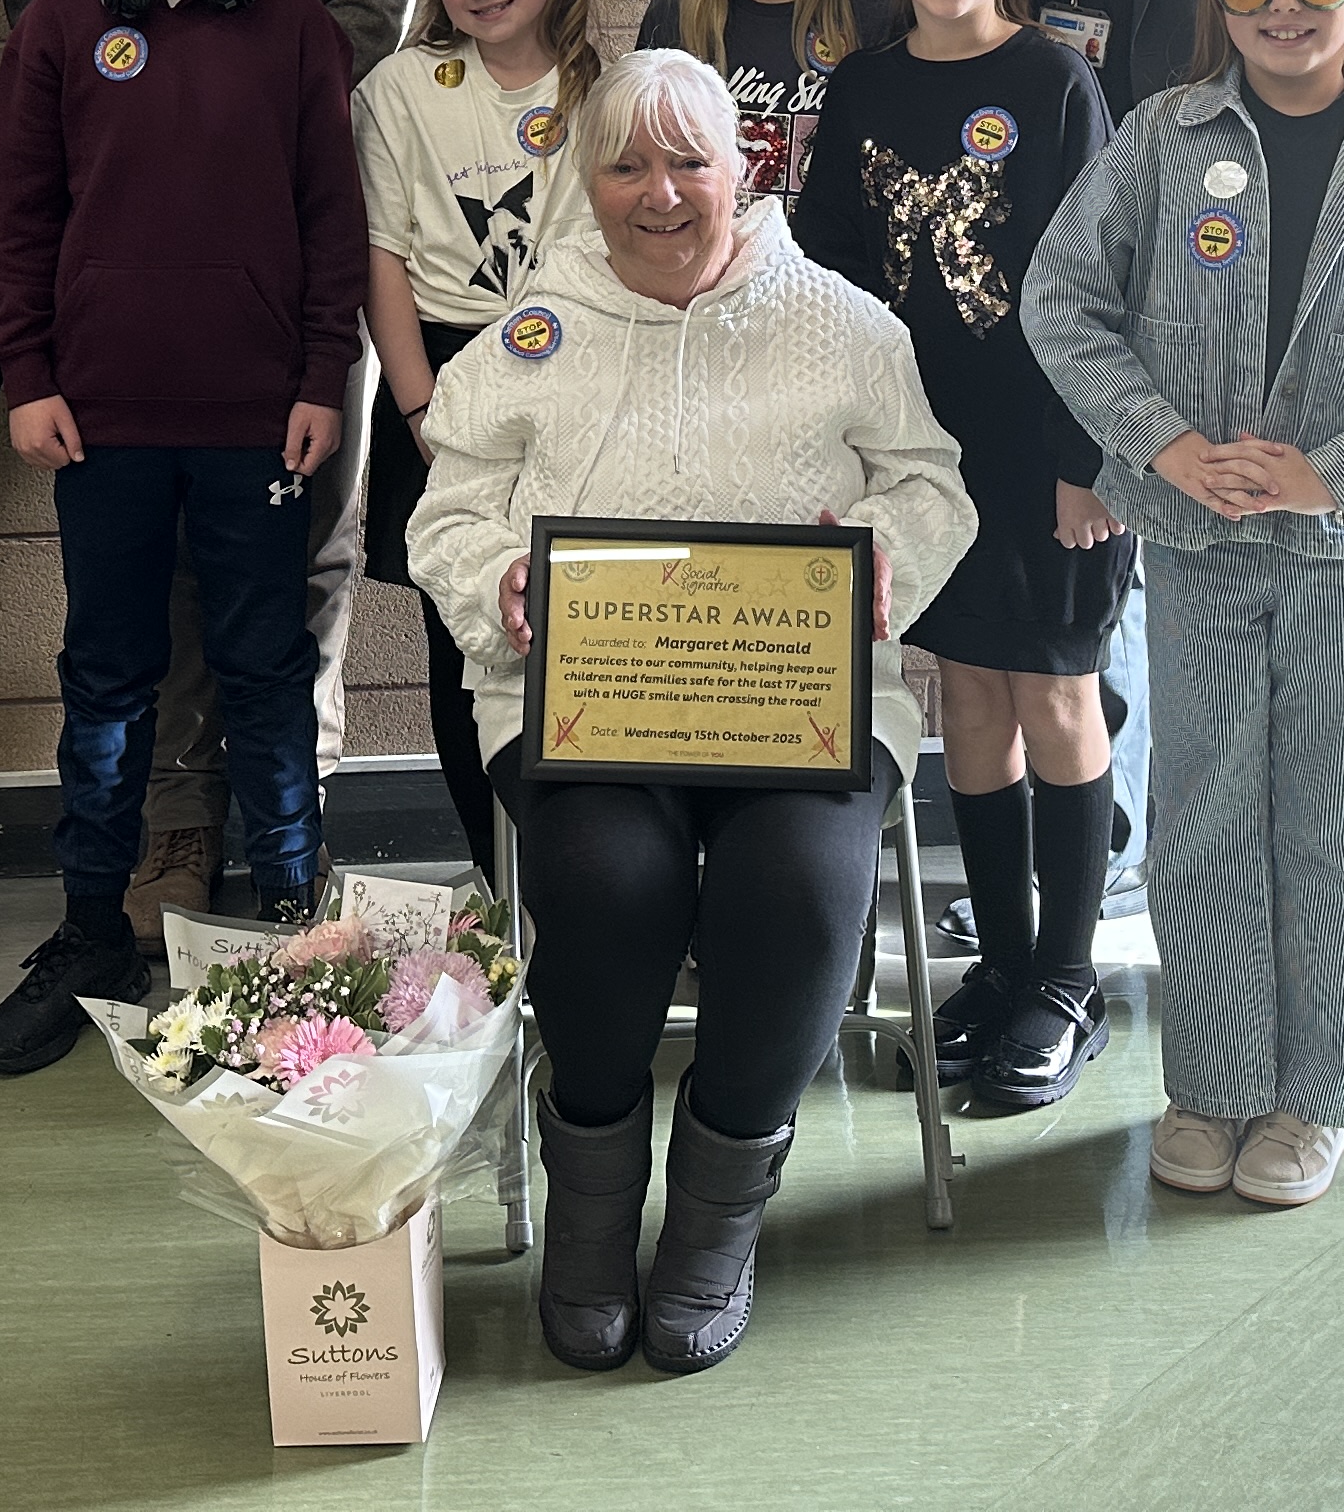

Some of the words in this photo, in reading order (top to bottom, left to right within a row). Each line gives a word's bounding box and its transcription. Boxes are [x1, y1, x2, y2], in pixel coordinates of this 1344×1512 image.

[106, 38, 125, 59] STOP
[726, 65, 786, 119] lling
[979, 120, 1004, 133] STOP
[1203, 226, 1229, 236] STOP
[516, 321, 543, 336] STOP
[681, 562, 720, 581] Social
[681, 576, 740, 596] signature
[567, 600, 722, 624] SUPERSTAR
[732, 607, 832, 629] AWARD
[580, 636, 630, 649] Awarded
[655, 635, 729, 652] Margaret
[732, 639, 811, 655] McDonald
[559, 654, 579, 665] For
[581, 656, 628, 667] services
[630, 657, 644, 667] to
[645, 659, 666, 668] our
[668, 659, 738, 673] community,
[739, 660, 784, 675] helping
[786, 662, 815, 677] keep
[816, 664, 838, 675] our
[564, 671, 613, 683] children
[614, 672, 638, 683] and
[640, 673, 687, 686] families
[689, 675, 715, 687] safe
[716, 676, 735, 688] for
[737, 678, 757, 688] the
[759, 678, 783, 689] last
[785, 680, 797, 689] 17
[798, 680, 832, 692] years
[573, 688, 601, 699] with
[602, 691, 610, 699] a
[612, 689, 647, 701] HUGE
[648, 691, 680, 702] smile
[682, 693, 715, 704] when
[716, 695, 766, 708] crossing
[767, 696, 788, 706] the
[789, 696, 822, 708] road!
[624, 726, 692, 742] Wednesday
[694, 730, 720, 742] 15th
[722, 731, 770, 743] October
[772, 732, 803, 745] 2025
[710, 751, 725, 759] YOU
[210, 938, 264, 955] Sutt
[177, 945, 209, 972] Hou
[287, 1344, 399, 1365] Suttons
[299, 1372, 333, 1383] House
[335, 1371, 346, 1383] of
[349, 1370, 390, 1381] Flowers
[320, 1390, 371, 1398] LIVERPOOL
